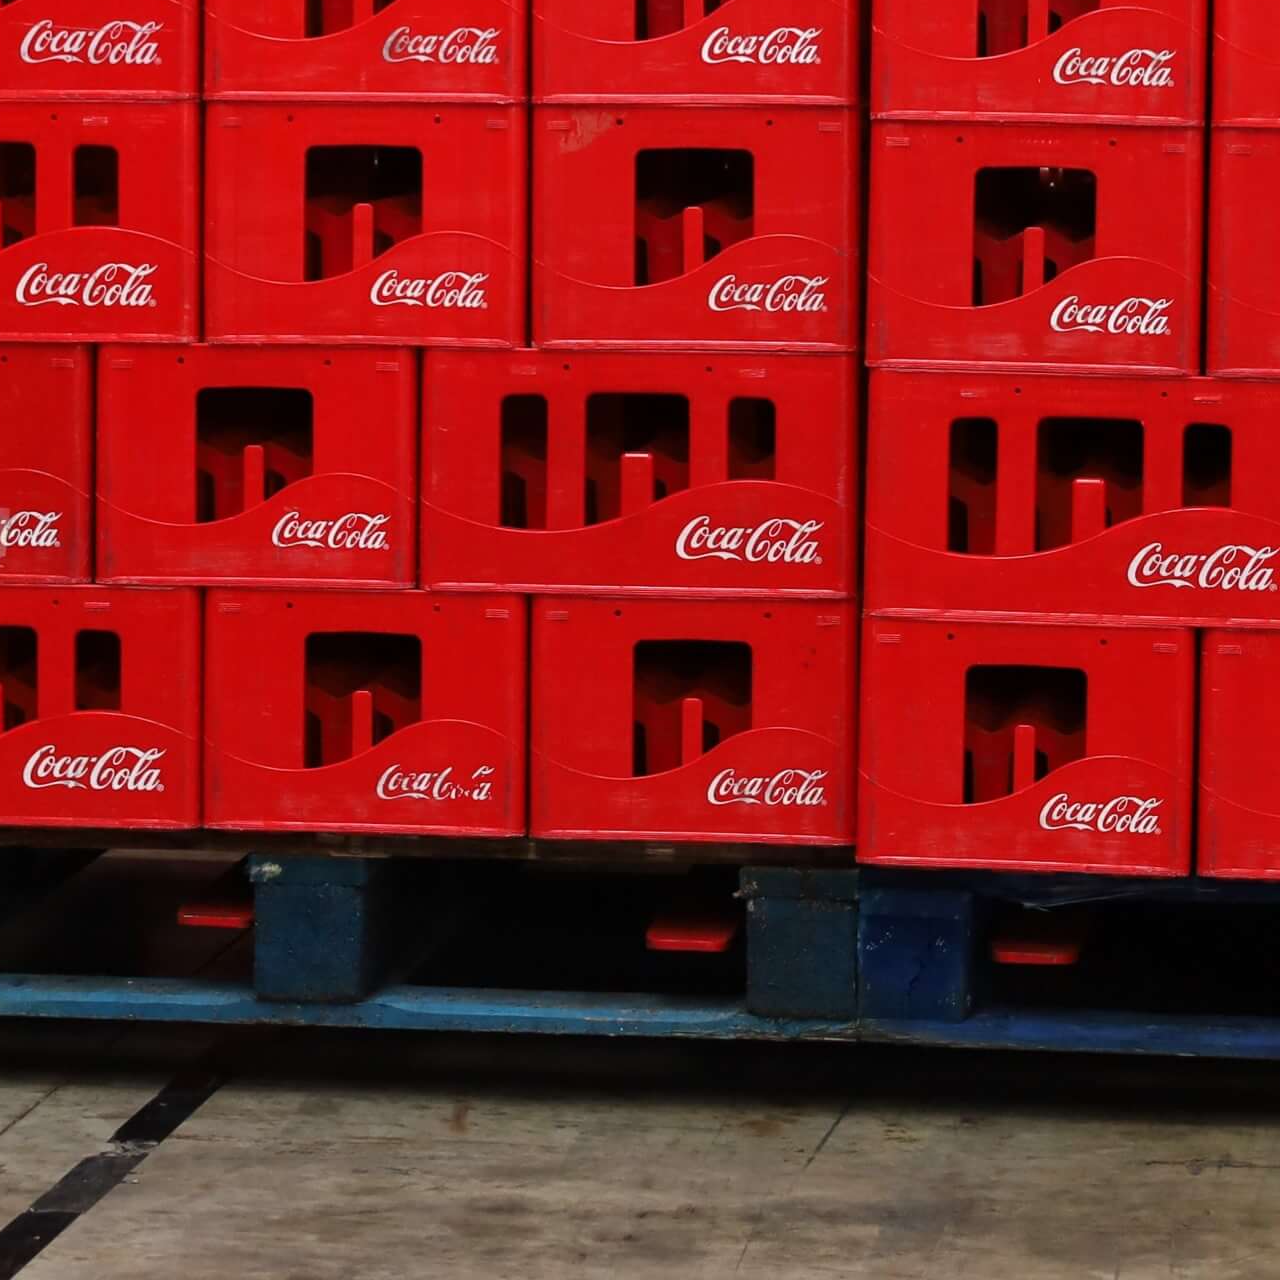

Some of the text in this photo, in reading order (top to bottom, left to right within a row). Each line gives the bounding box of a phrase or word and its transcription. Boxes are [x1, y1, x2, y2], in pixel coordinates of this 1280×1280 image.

[20, 20, 163, 64] Coca-Cola
[383, 26, 500, 64] Coca-Cola
[701, 27, 822, 64] Coca-Cola
[1053, 48, 1176, 87] Coca-Cola
[16, 263, 157, 306] Coca-Cola
[370, 270, 489, 308] Coca-Cola
[708, 275, 828, 312] Coca-Cola
[1050, 296, 1173, 335] Coca-Cola
[272, 512, 391, 550] Coca-Cola
[676, 516, 824, 564] Coca-Cola
[1127, 543, 1280, 592] Coca-Cola
[23, 745, 166, 792] Coca-Cola
[707, 769, 828, 805] Coca-Cola
[1040, 793, 1163, 834] Coca-Cola
